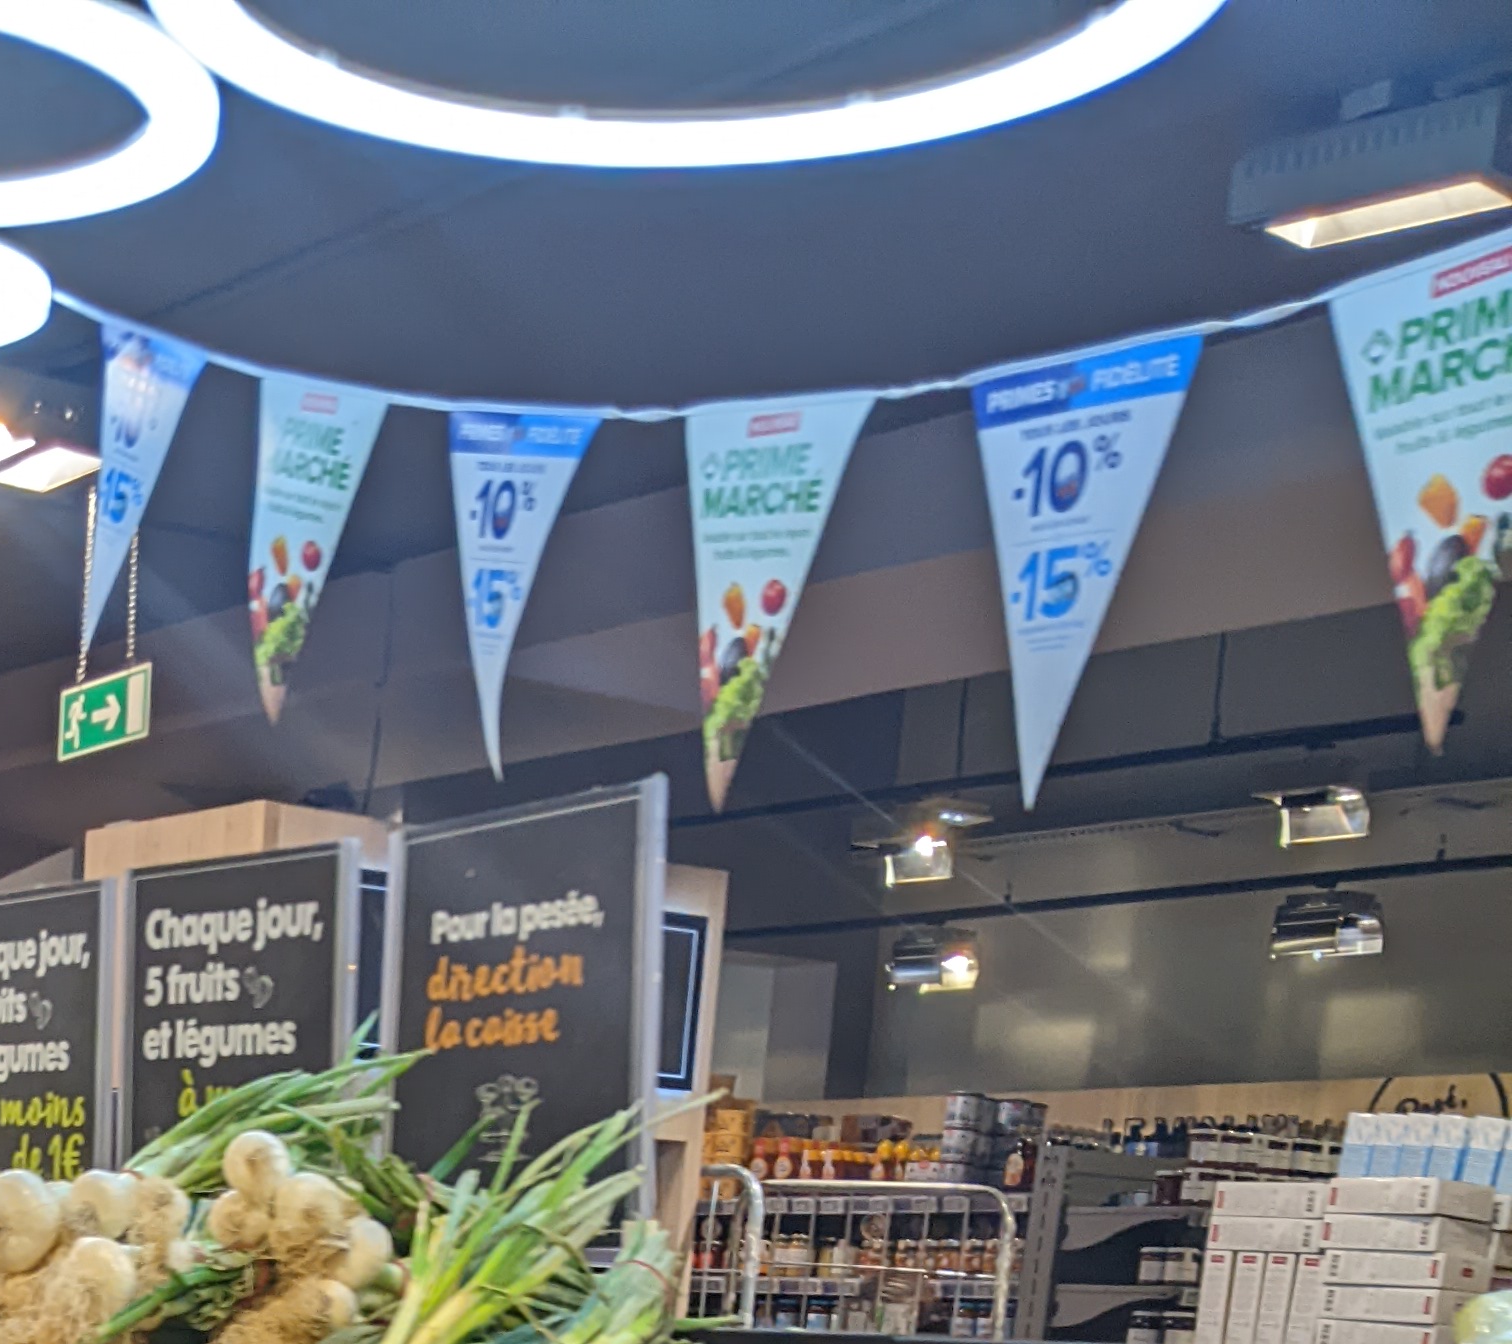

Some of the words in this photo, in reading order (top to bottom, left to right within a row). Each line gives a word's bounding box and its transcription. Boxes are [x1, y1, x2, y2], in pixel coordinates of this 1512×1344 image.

[1398, 288, 1512, 360] PRIM
[722, 443, 813, 481] PRIME
[700, 469, 824, 519] MARCHÉ
[145, 908, 253, 955] Chaque
[252, 898, 324, 951] jour,
[431, 910, 489, 945] Pour
[490, 902, 517, 936] la
[36, 929, 90, 977] jour,
[426, 946, 584, 1001] direction
[144, 966, 164, 1007] 5
[167, 962, 240, 1004] fruits
[143, 1020, 172, 1061] et
[175, 1019, 297, 1068] légumes
[425, 1006, 462, 1055] la
[465, 1008, 560, 1048] caisse
[0, 1092, 85, 1128] moins
[12, 1133, 43, 1174] de
